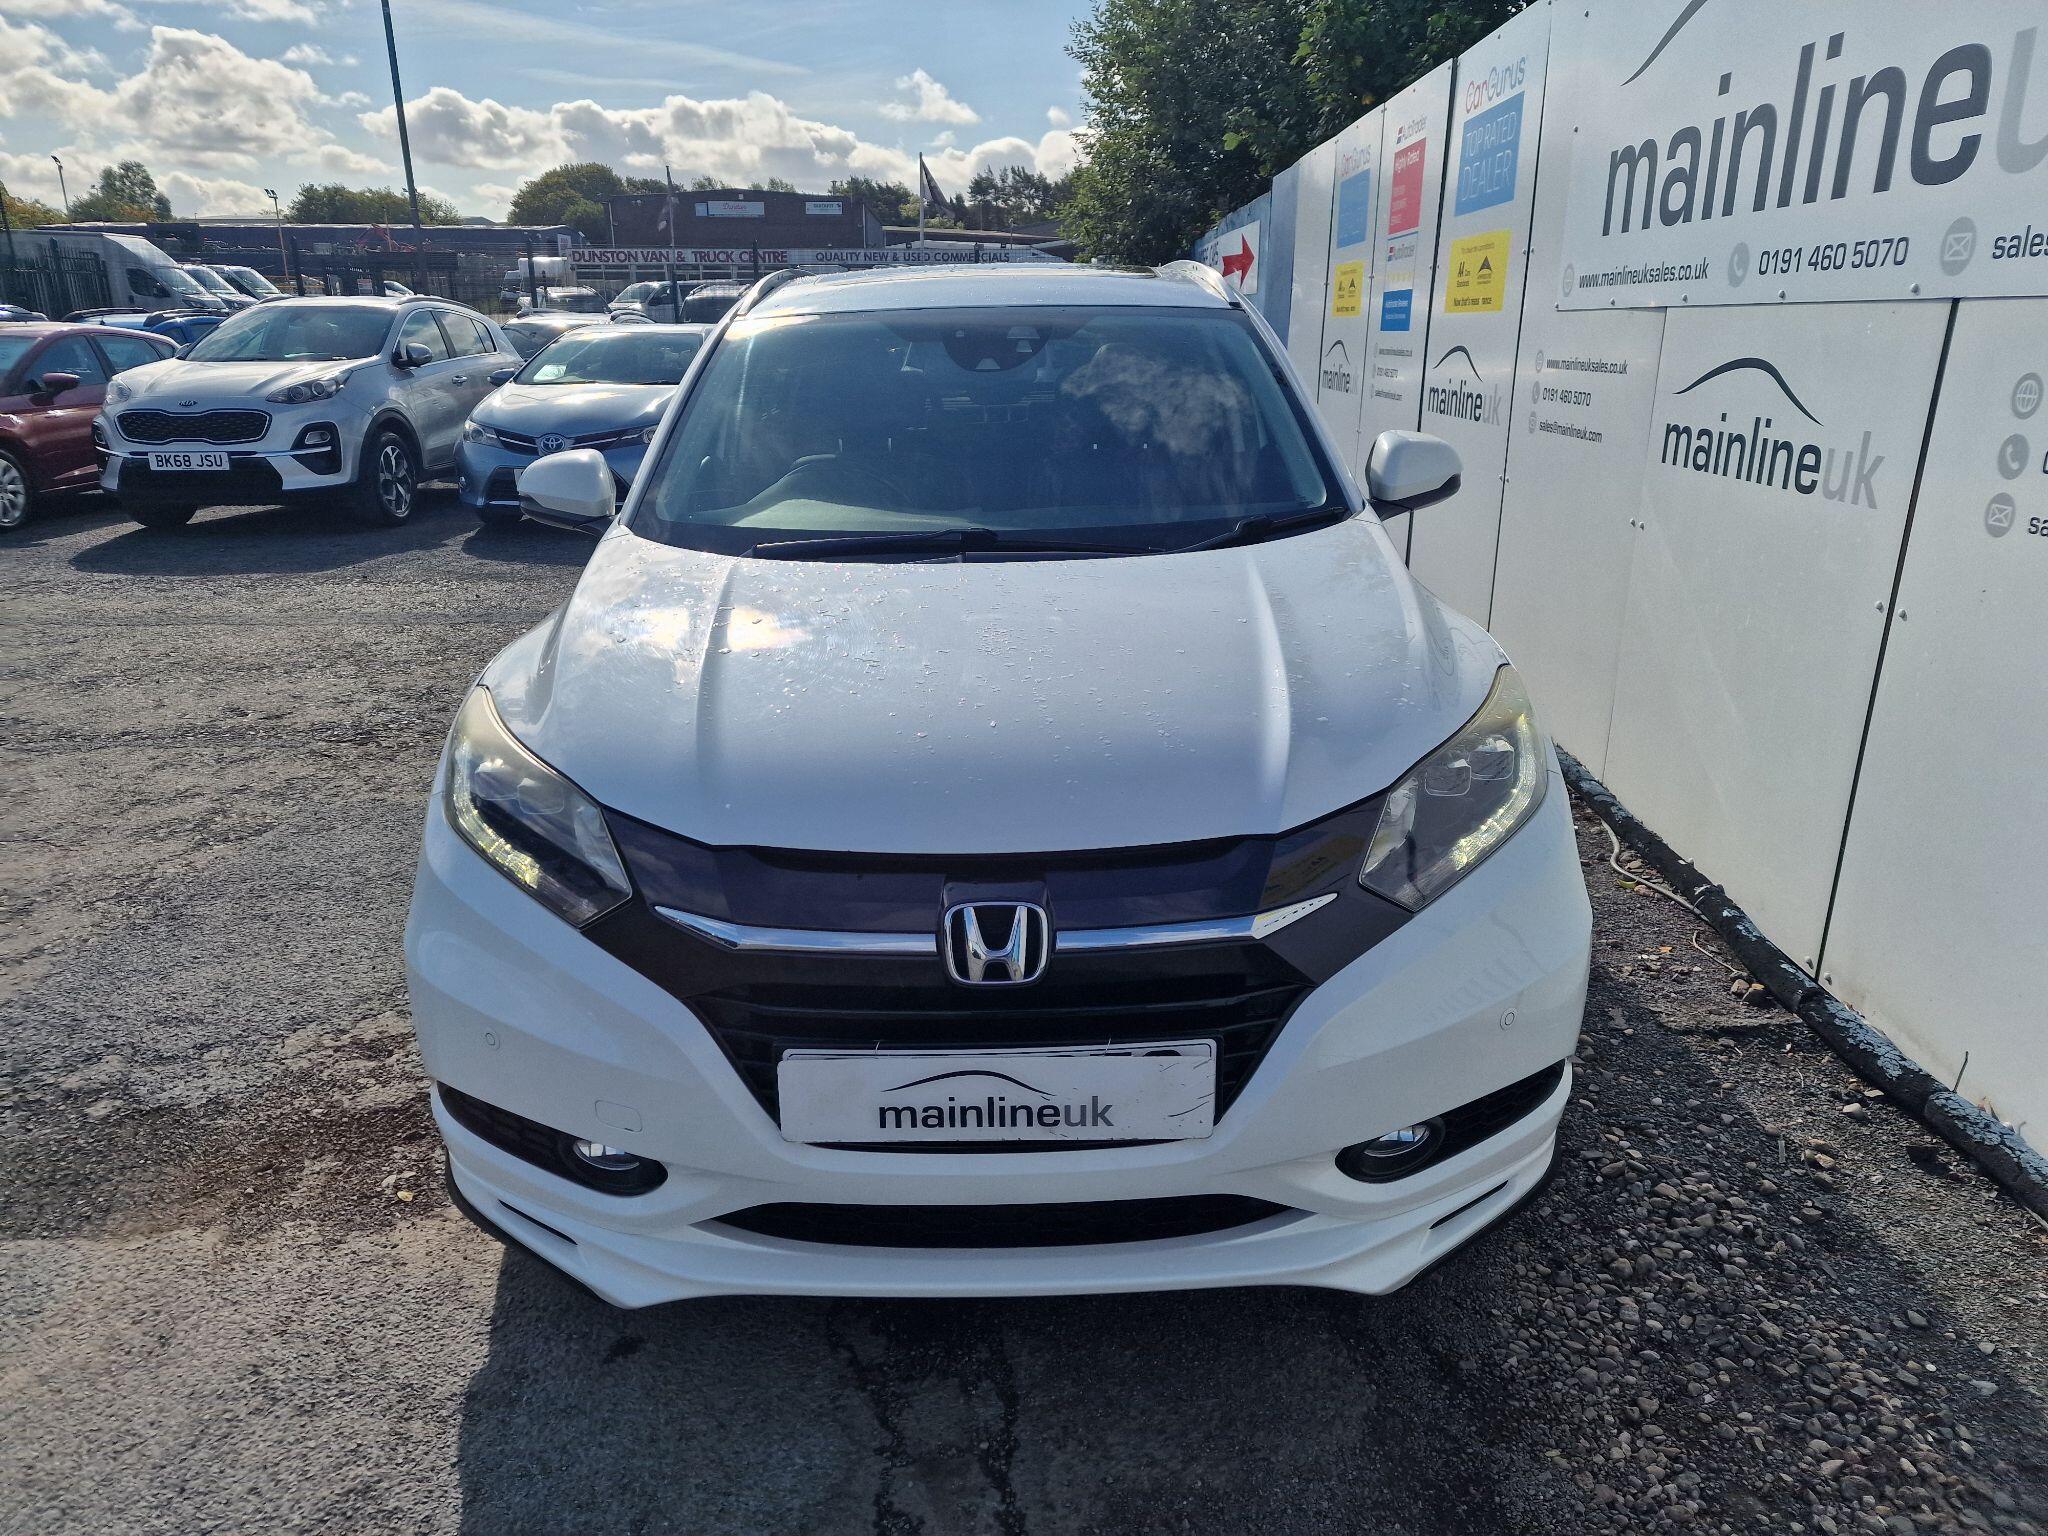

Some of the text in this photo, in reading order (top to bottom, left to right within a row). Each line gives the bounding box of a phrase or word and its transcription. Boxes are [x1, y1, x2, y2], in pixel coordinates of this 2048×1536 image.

[1466, 56, 1526, 114] CarGurus
[1466, 111, 1517, 159] TOP RATED
[1461, 150, 1512, 201] DEALER
[571, 250, 639, 263] DUNSTON
[641, 250, 670, 263] VAN
[676, 250, 686, 263] &
[693, 250, 736, 263] TRUCK
[815, 251, 860, 262] QUALITY
[863, 251, 890, 262] NEW
[892, 252, 899, 262] &
[934, 252, 1010, 263] COMMECIALS
[1579, 256, 1709, 288] www.mainlineuksales.co.uk
[1758, 236, 1910, 275] 0191 460 5070
[1546, 356, 1628, 375] www.mainlineuksales.co.uk
[1428, 378, 1502, 426] mainlineuk
[1542, 387, 1592, 406] 0191 460 5070
[1539, 420, 1603, 444] sales@mainlineuk.com
[155, 454, 223, 467] BK68 JSU
[1661, 412, 1885, 510] mainlineuk
[879, 1095, 1115, 1129] mainlineuk
